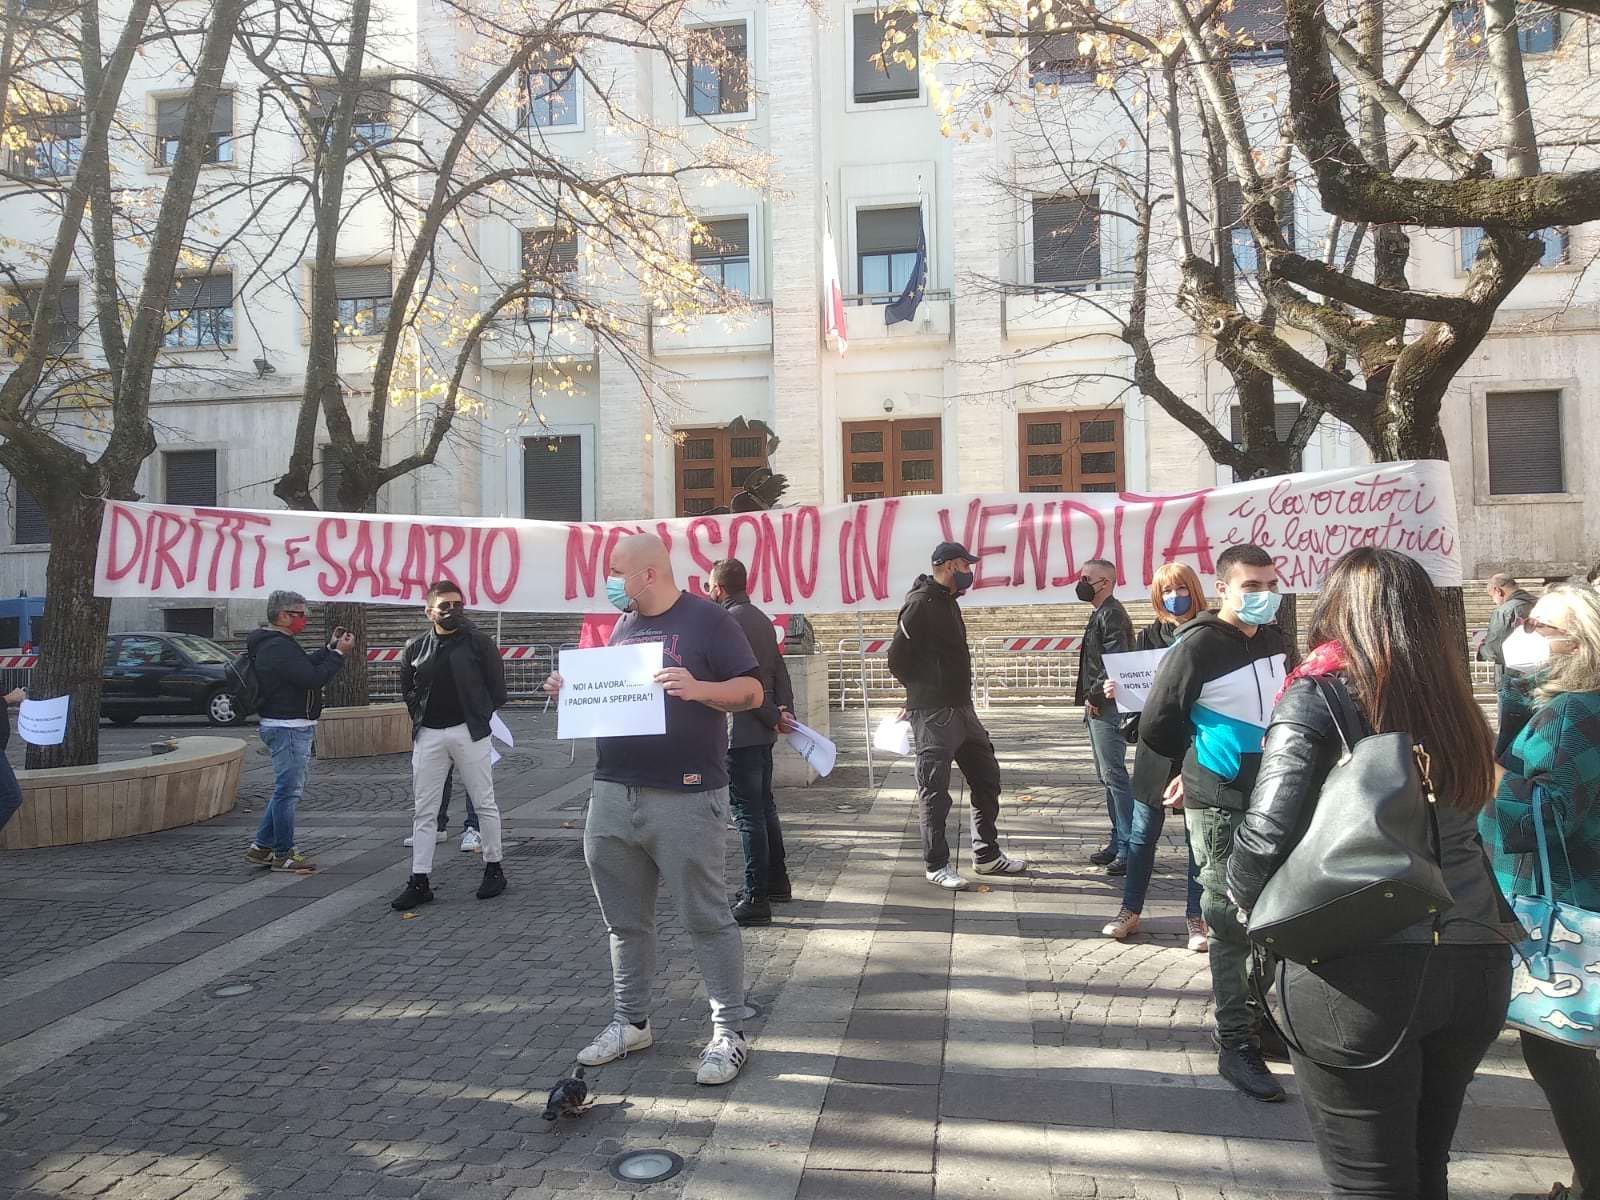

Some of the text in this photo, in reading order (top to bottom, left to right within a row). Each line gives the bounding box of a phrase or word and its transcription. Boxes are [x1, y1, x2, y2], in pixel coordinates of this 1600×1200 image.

[1263, 474, 1436, 516] lavoratori
[106, 506, 271, 591] DIRITTI
[316, 518, 520, 605] SALARIO
[686, 504, 821, 605] SONO
[839, 500, 900, 604] IN
[936, 488, 1216, 596] VENDITA
[1220, 511, 1455, 556] e le lavoratrici
[569, 697, 601, 706] PADRONI
[602, 696, 608, 704] A
[573, 683, 586, 691] NOI
[587, 682, 593, 690] A
